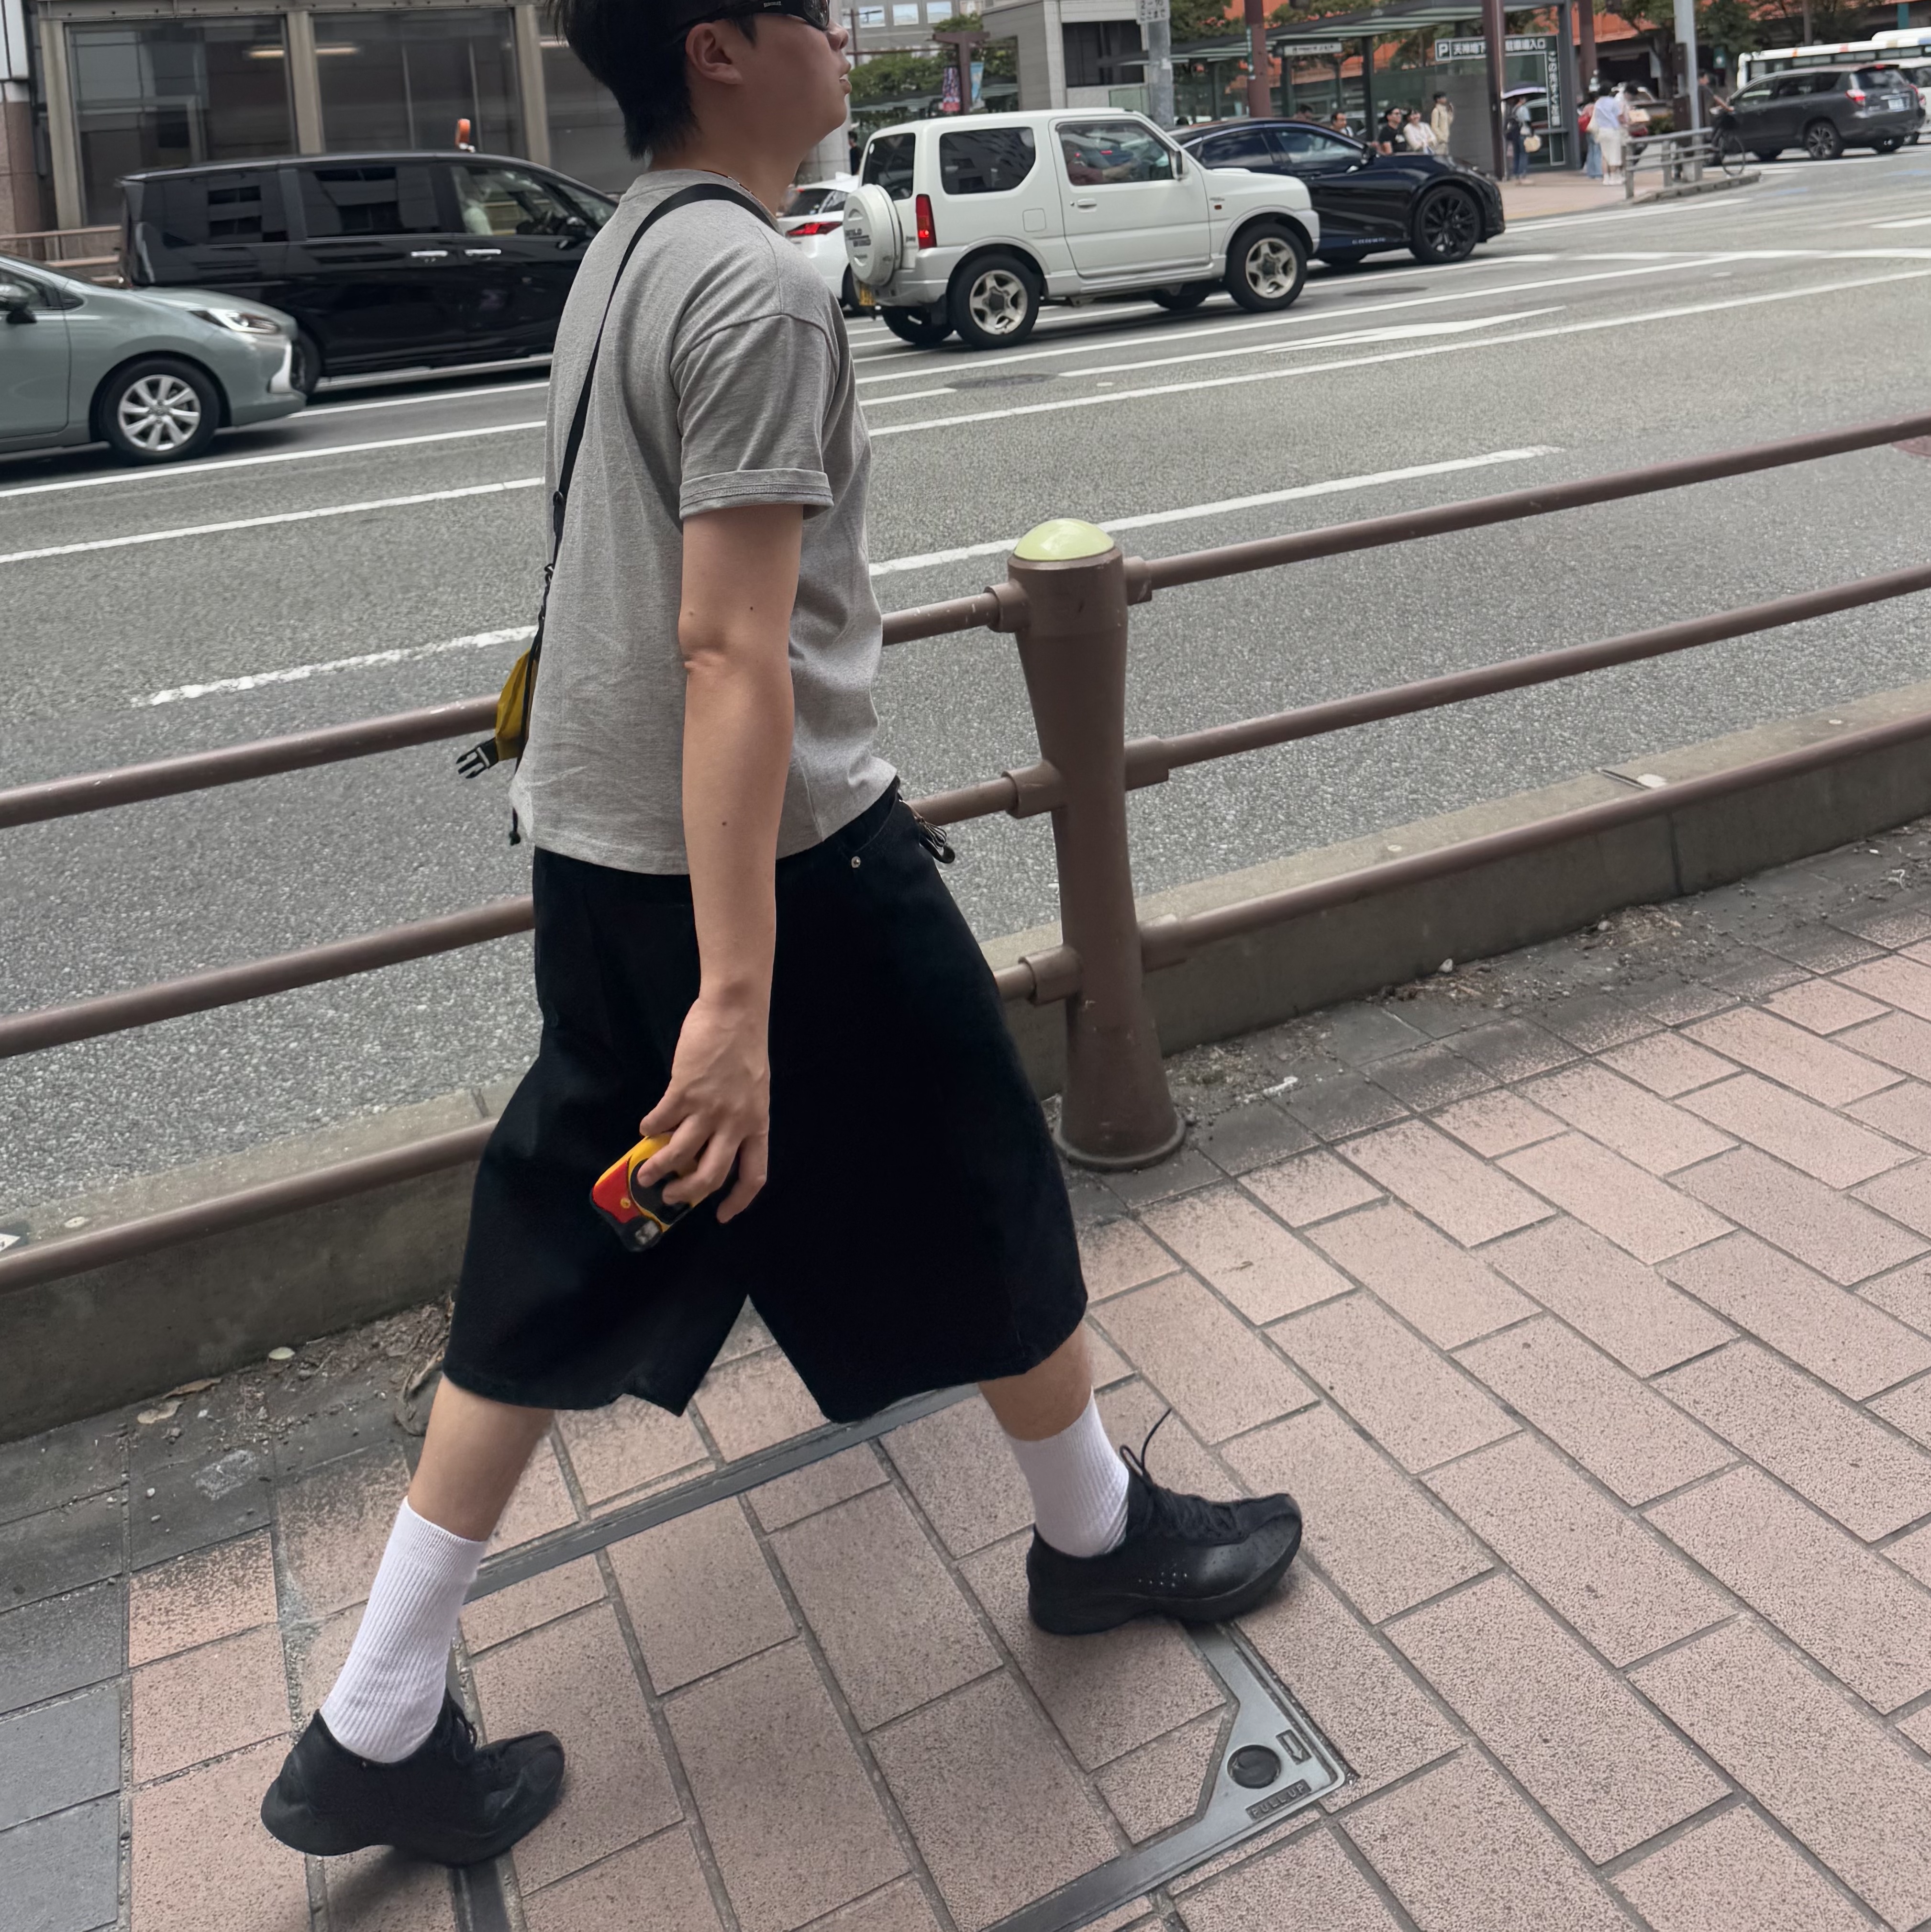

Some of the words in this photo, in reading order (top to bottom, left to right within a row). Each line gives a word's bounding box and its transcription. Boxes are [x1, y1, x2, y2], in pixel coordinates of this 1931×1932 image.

[1438, 43, 1449, 57] P
[1252, 1797, 1286, 1818] PULL
[1287, 1784, 1303, 1798] UP
